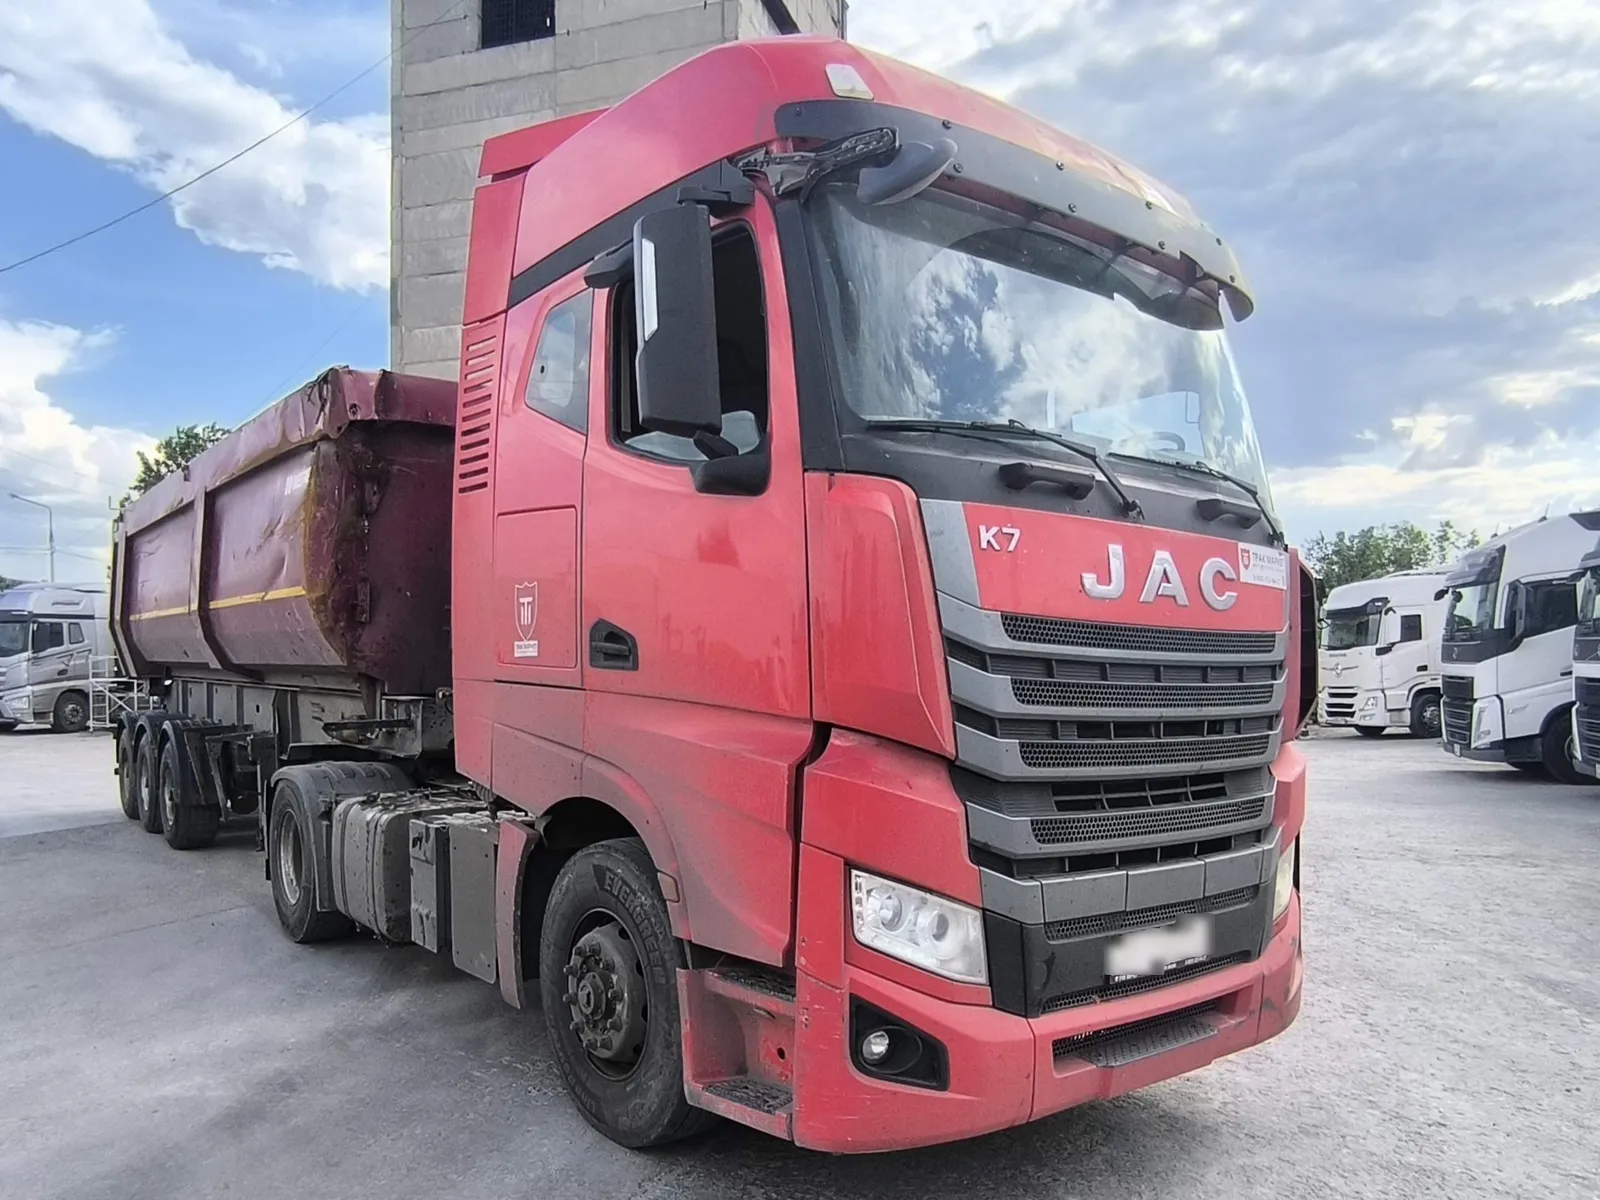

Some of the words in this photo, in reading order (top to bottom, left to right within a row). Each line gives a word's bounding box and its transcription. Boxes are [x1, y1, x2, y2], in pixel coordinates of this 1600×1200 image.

[979, 524, 1021, 552] K7
[1081, 543, 1238, 611] JAC
[603, 868, 666, 985] EVERGREEN
